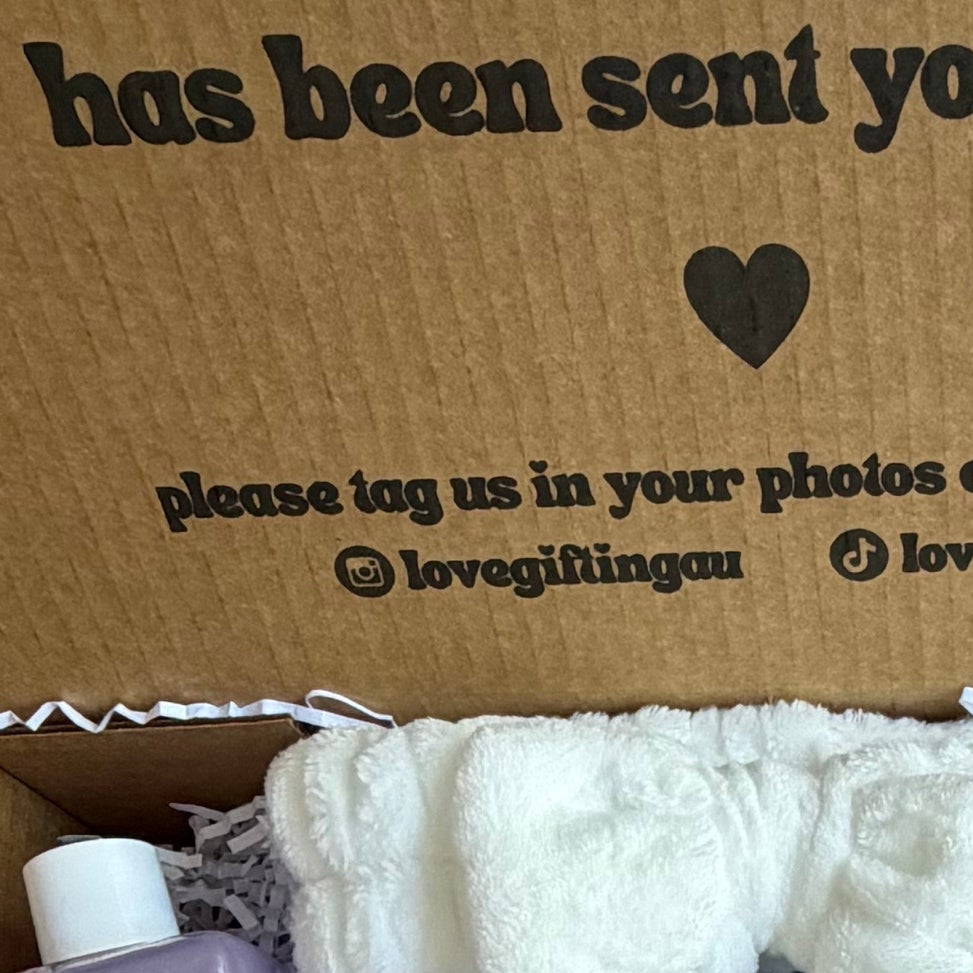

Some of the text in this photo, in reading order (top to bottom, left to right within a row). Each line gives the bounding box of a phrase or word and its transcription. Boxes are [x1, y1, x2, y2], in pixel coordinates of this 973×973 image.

[23, 41, 256, 148] has
[262, 34, 563, 139] been
[582, 24, 829, 131] sent
[155, 471, 345, 533] please
[349, 470, 445, 525] tag
[453, 477, 521, 511] us
[529, 460, 595, 508] in
[604, 467, 745, 519] your
[757, 451, 946, 513] photos
[399, 542, 744, 598] lovegiftingau
